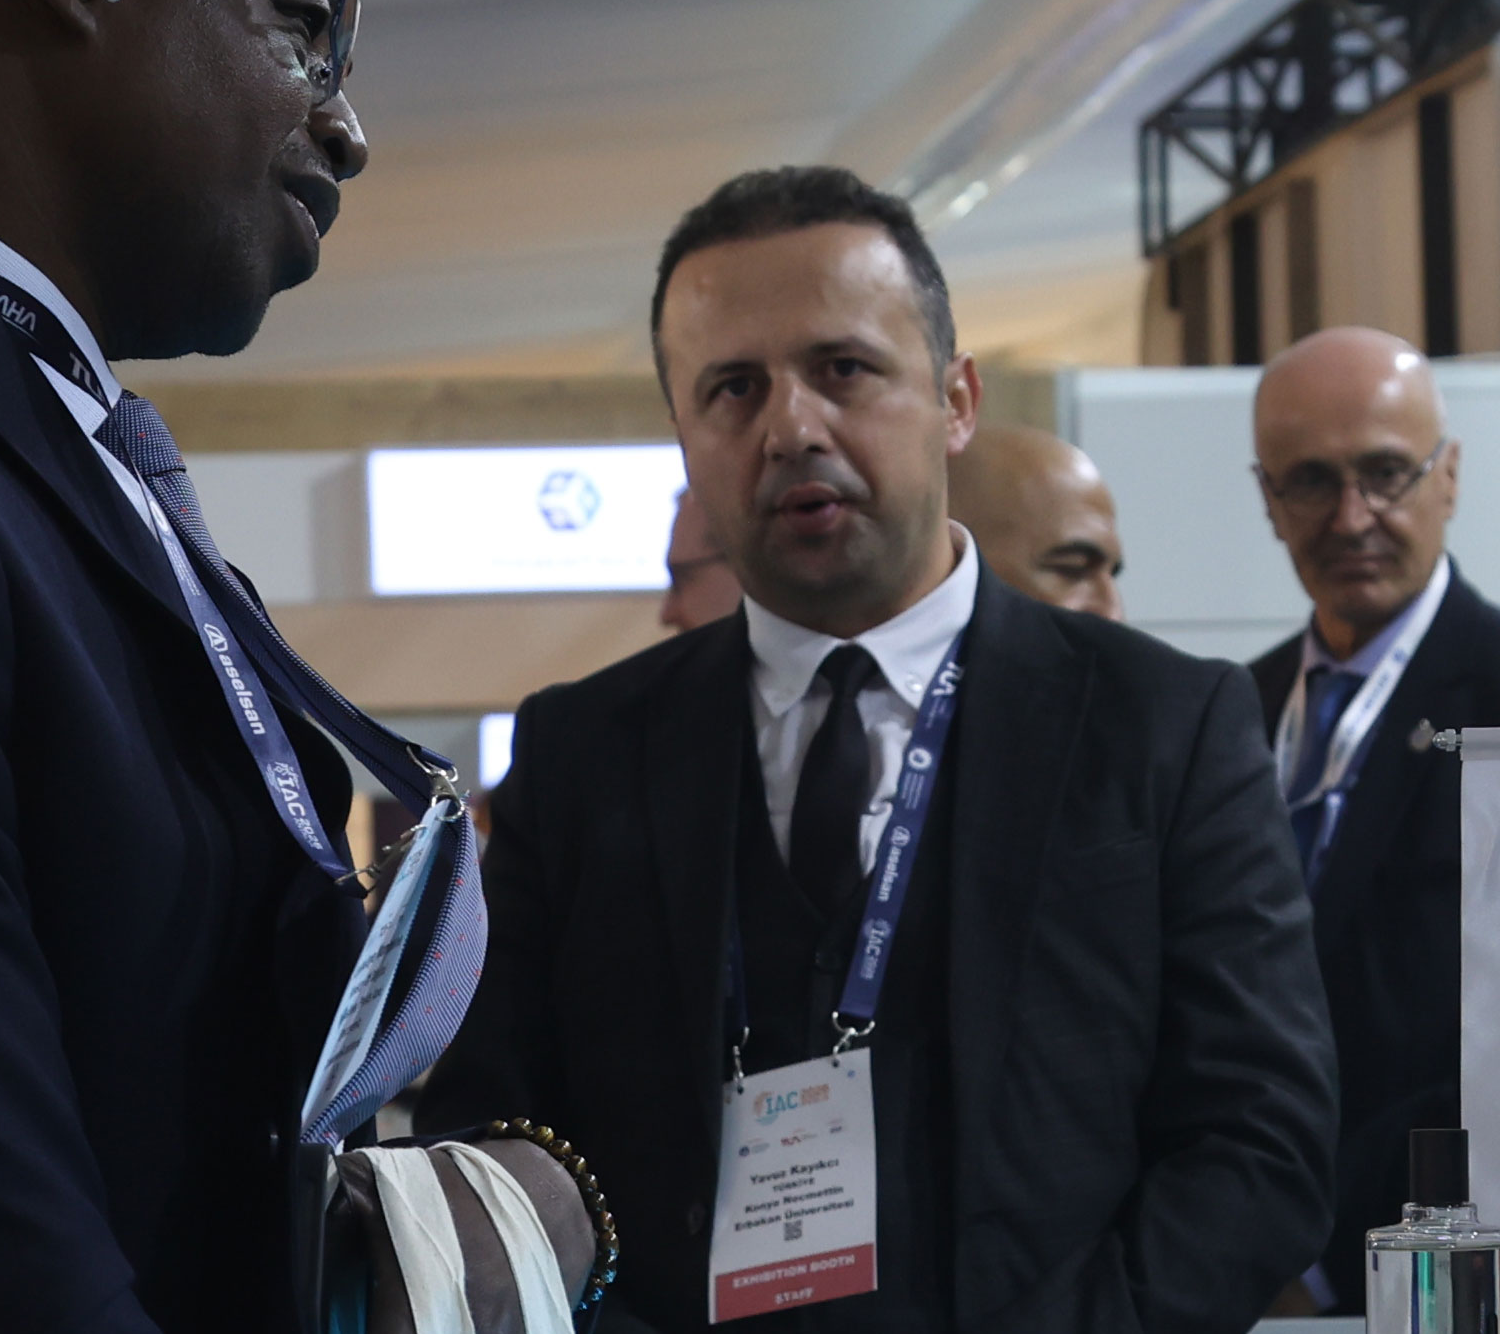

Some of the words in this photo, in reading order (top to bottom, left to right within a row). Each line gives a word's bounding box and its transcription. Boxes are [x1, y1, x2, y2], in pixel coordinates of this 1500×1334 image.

[218, 653, 266, 735] aselsan
[277, 776, 306, 818] IAC
[766, 1091, 798, 1115] IAC
[745, 1199, 780, 1214] Konya
[783, 1185, 844, 1205] Necmettin
[734, 1214, 783, 1232] Erbakan
[732, 1265, 807, 1289] EXHIBITION
[809, 1254, 856, 1273] BOOTH
[775, 1287, 814, 1305] STAFF
